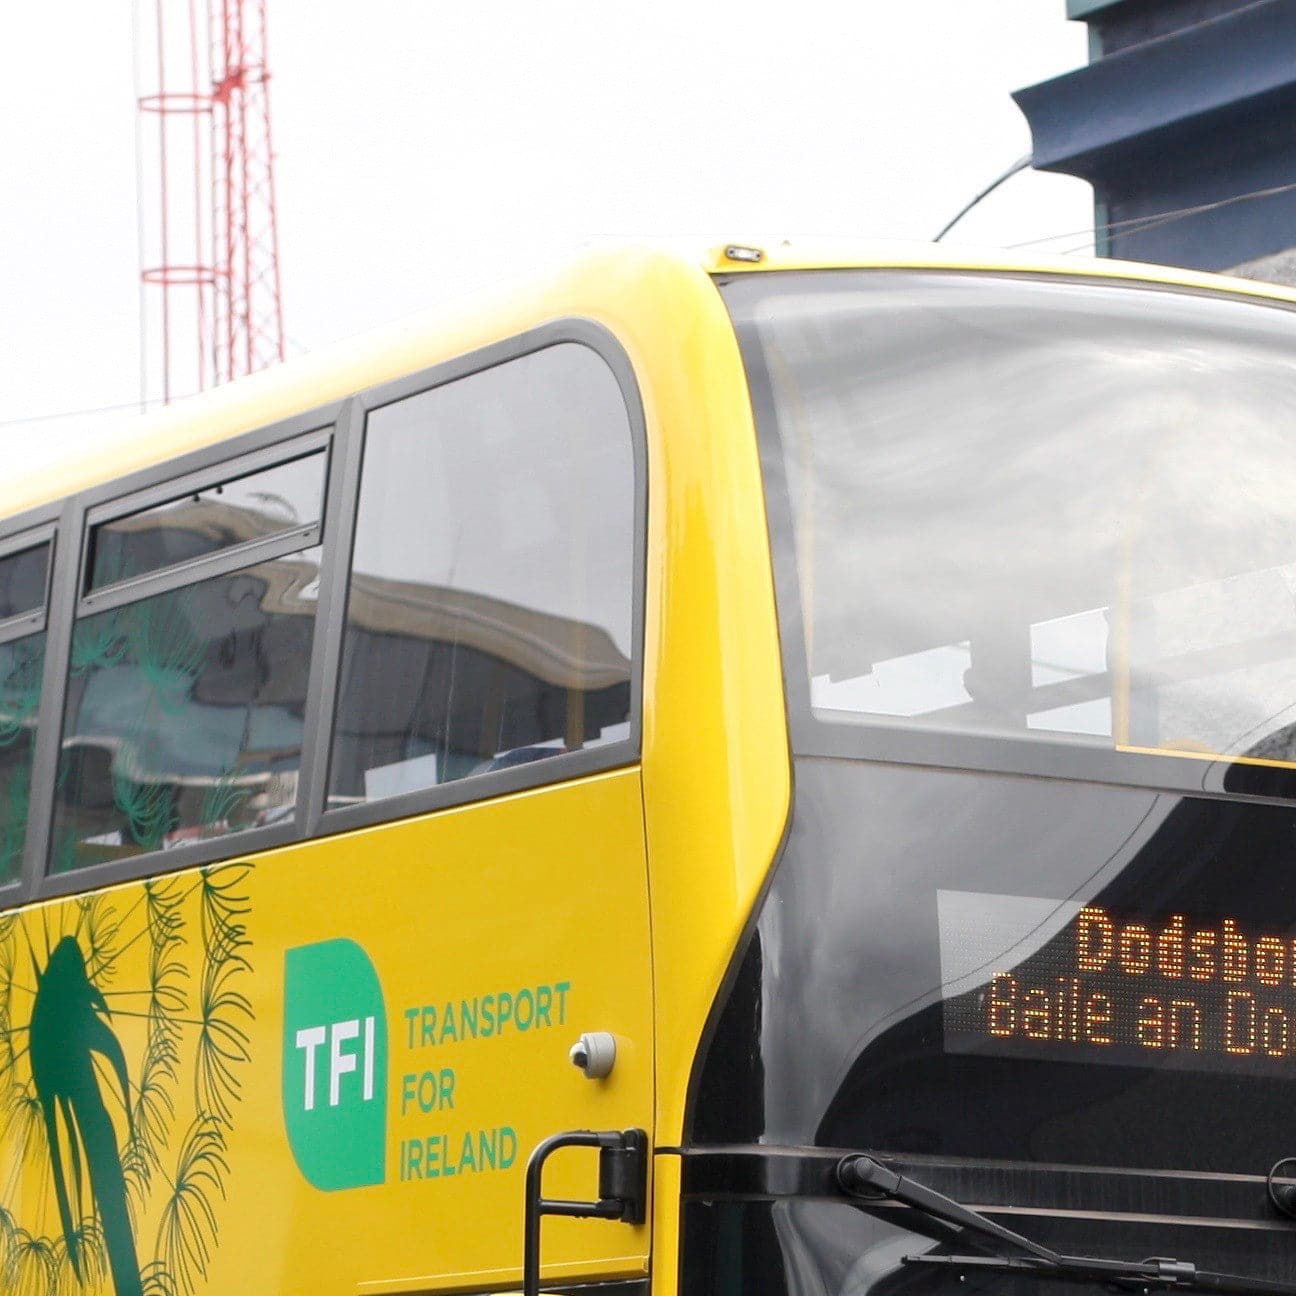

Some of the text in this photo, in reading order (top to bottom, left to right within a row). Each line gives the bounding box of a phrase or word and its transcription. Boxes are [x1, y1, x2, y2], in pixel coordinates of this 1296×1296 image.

[405, 981, 571, 1049] TRANSPORT
[990, 972, 1111, 1044] Baile
[1138, 997, 1201, 1050] an
[295, 1016, 375, 1111] TFI
[402, 1068, 456, 1116] FOR
[400, 1126, 518, 1181] IRELAND
